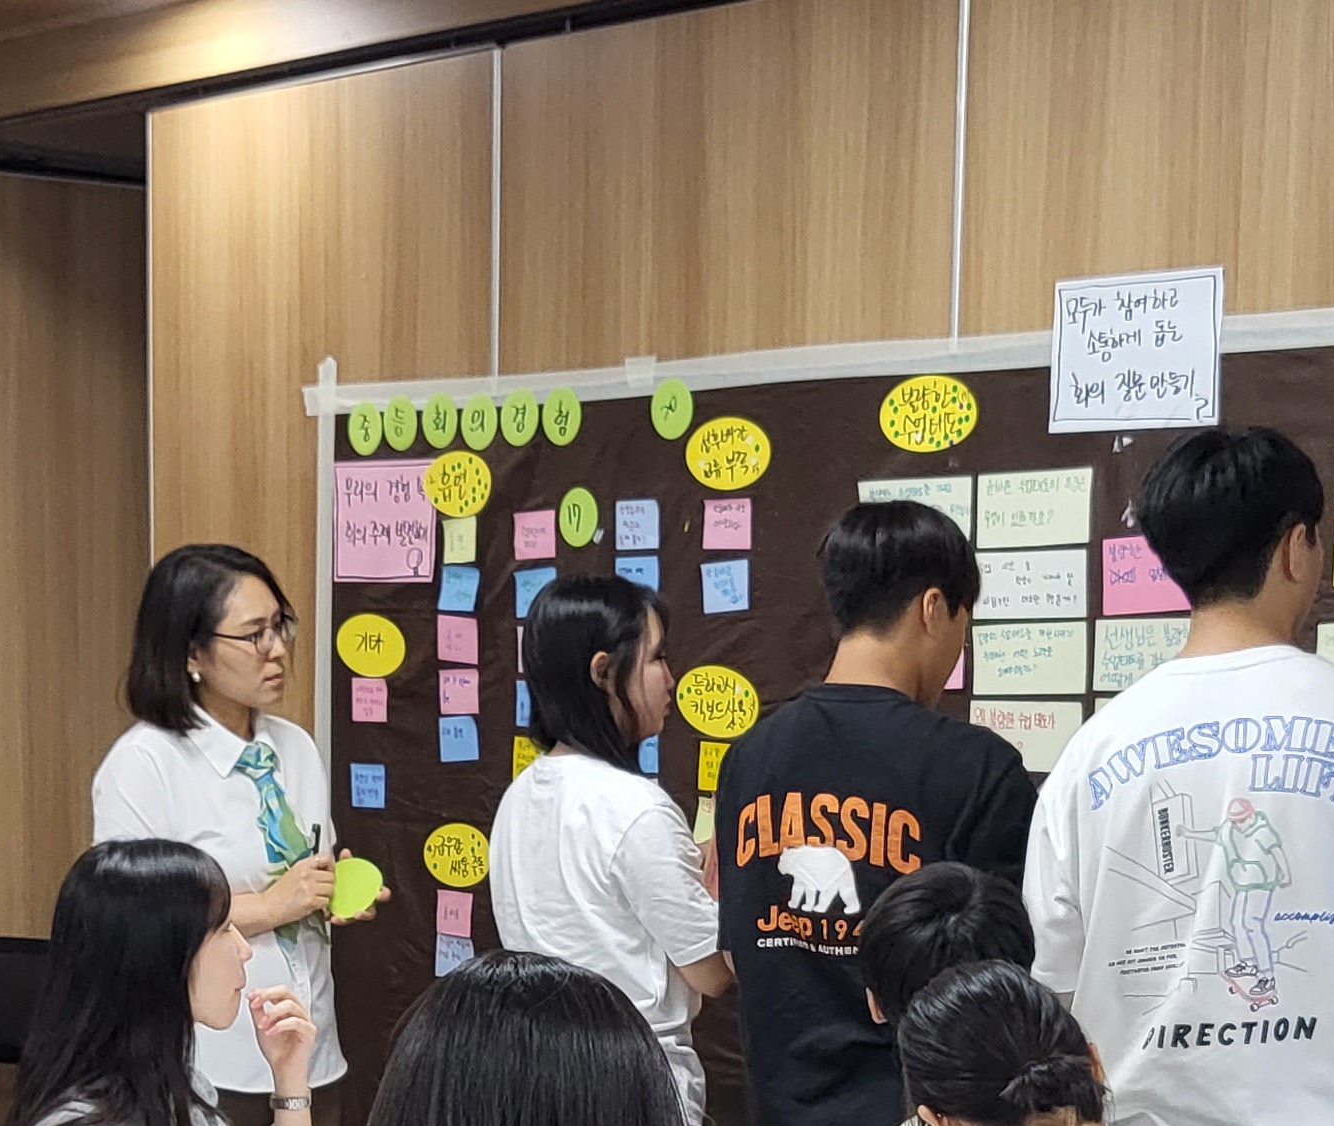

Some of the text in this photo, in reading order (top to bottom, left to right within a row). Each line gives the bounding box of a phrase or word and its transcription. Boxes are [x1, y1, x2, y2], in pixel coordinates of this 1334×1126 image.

[1066, 296, 1106, 334] 모두가
[1087, 328, 1141, 362] 소통하게
[1070, 372, 1105, 408] 회의
[345, 477, 378, 508] 우리의
[354, 632, 385, 654] 기타
[1105, 625, 1156, 650] 선생님은
[736, 791, 922, 875] CLASSIC
